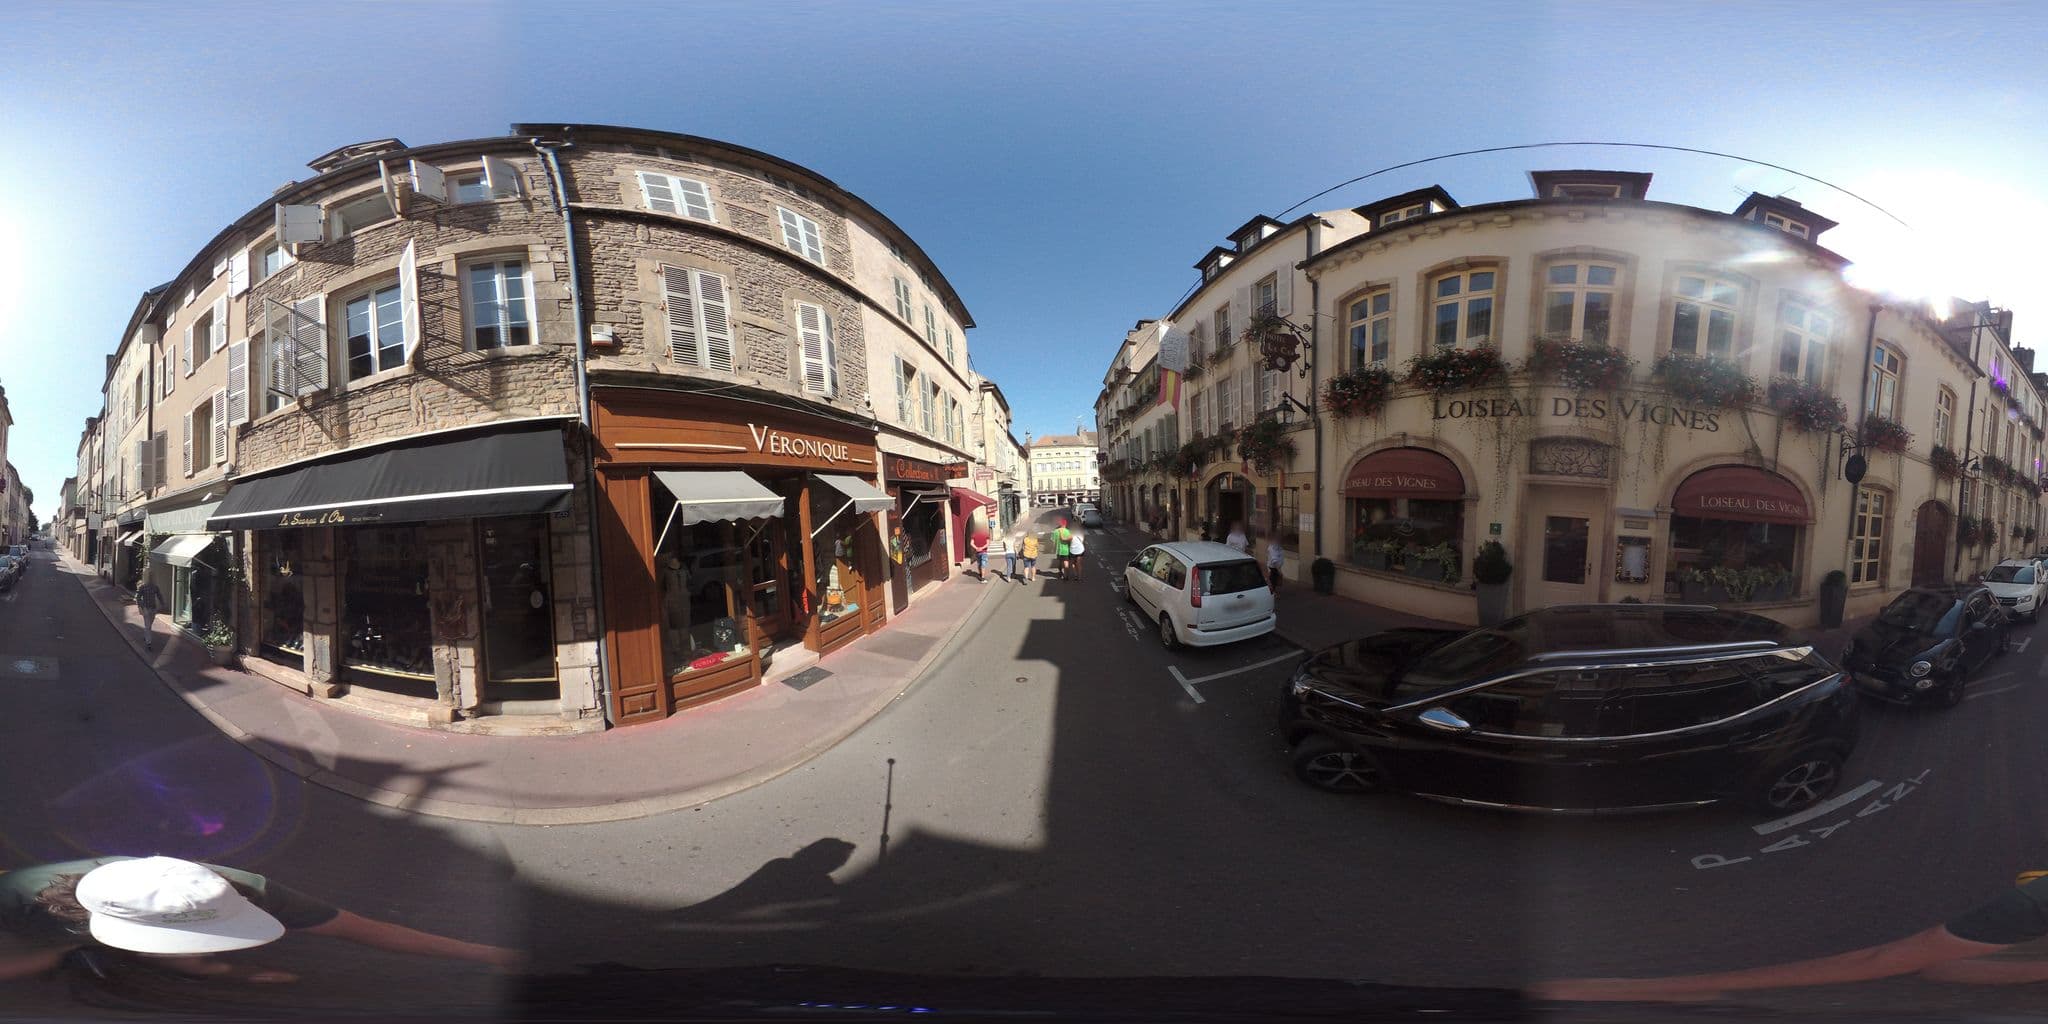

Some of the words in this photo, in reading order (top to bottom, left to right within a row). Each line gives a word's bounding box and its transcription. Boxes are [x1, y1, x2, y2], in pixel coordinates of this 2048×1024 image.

[1432, 397, 1540, 420] LOISEAU
[1552, 397, 1606, 419] DES
[1616, 397, 1720, 433] VIGNES
[747, 423, 849, 464] VÉRONIQUE
[1374, 477, 1393, 487] DES
[1397, 475, 1436, 489] VIGNES
[1700, 495, 1750, 509] LOISEAU
[1756, 499, 1776, 511] DES
[1690, 768, 1932, 870] PAYANT
